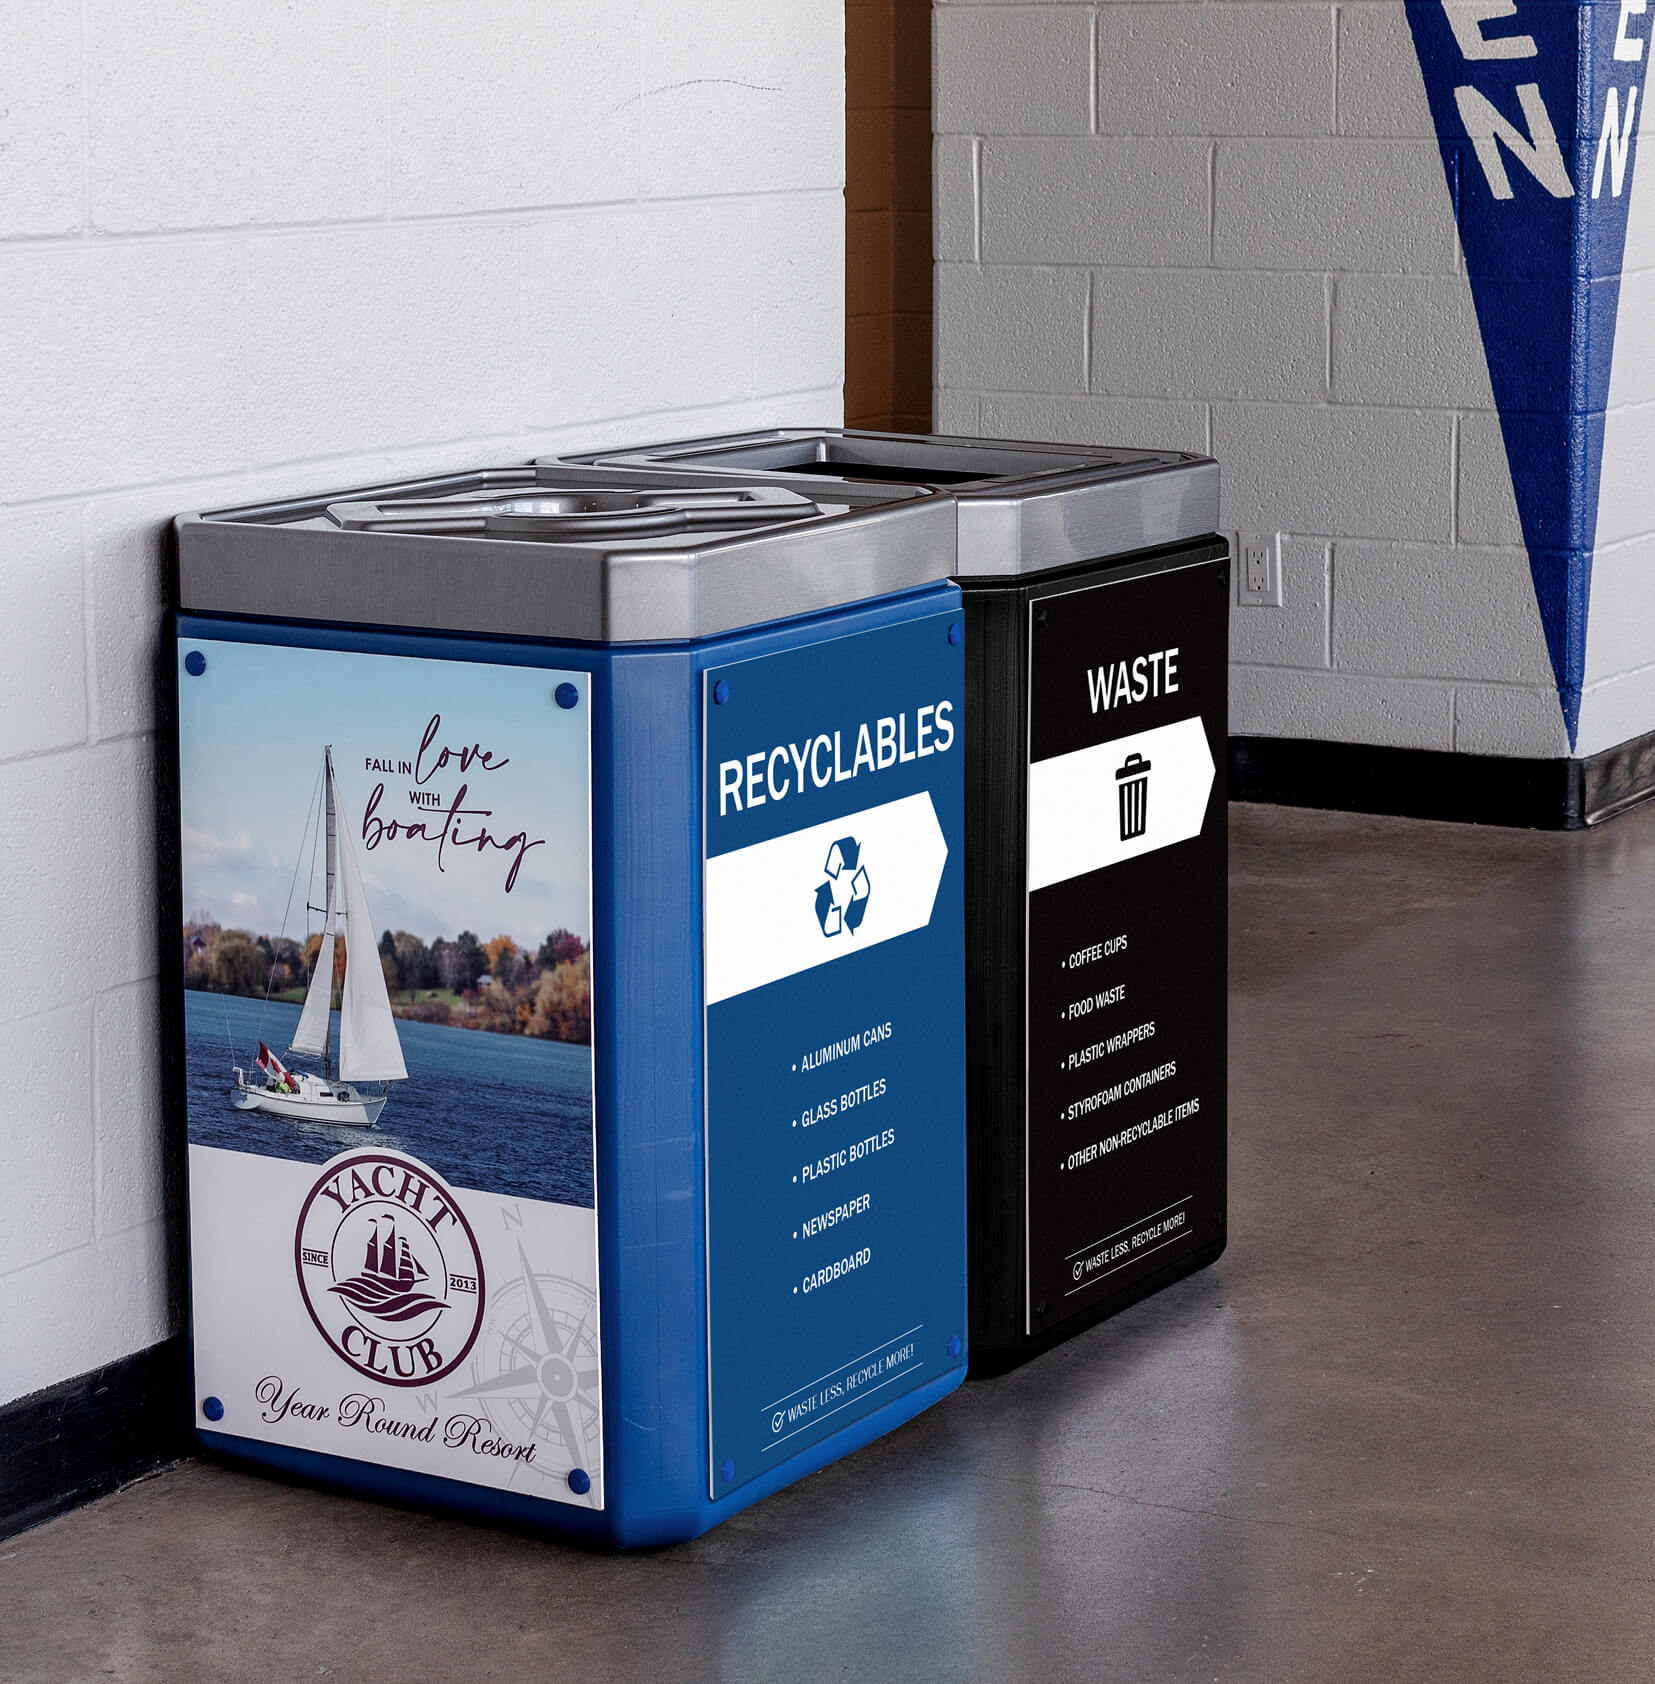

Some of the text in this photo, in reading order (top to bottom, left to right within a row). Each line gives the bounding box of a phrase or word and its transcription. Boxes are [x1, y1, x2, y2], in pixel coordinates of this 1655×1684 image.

[1087, 648, 1179, 714] WASTE
[365, 714, 510, 785] FALL IN love
[719, 700, 955, 817] RECYCLABLES
[409, 790, 441, 806] WITH
[362, 783, 546, 893] boating
[1069, 934, 1128, 969] COFFEE CUPS
[1068, 984, 1126, 1021] FOOD WASTE
[801, 1021, 893, 1073] ALUMINUM CANS
[1068, 1021, 1155, 1071] PLASTIC WRAPPERS
[801, 1078, 887, 1128] GLASS BOTTLES
[1067, 1060, 1177, 1120] STYROFOAM CONTAINERS
[802, 1128, 895, 1184] PLASTIC BOTTLES
[1067, 1097, 1200, 1170] OTHER NON-RECYCLABLE ITEMS
[320, 1164, 458, 1233] YACHT
[802, 1193, 871, 1239] NEWSPAPER
[302, 1251, 329, 1265] SINCE
[1085, 1249, 1110, 1272] WASTE
[1131, 1223, 1162, 1250] RECYCLE
[1162, 1210, 1186, 1234] MORE!
[450, 1277, 477, 1291] 2013
[802, 1247, 871, 1294] CARDBOARD
[340, 1325, 444, 1378] CLUB
[788, 1343, 915, 1423] WASTE LESS, RECYCLE MORE!
[254, 1375, 537, 1464] Year Round Resort
